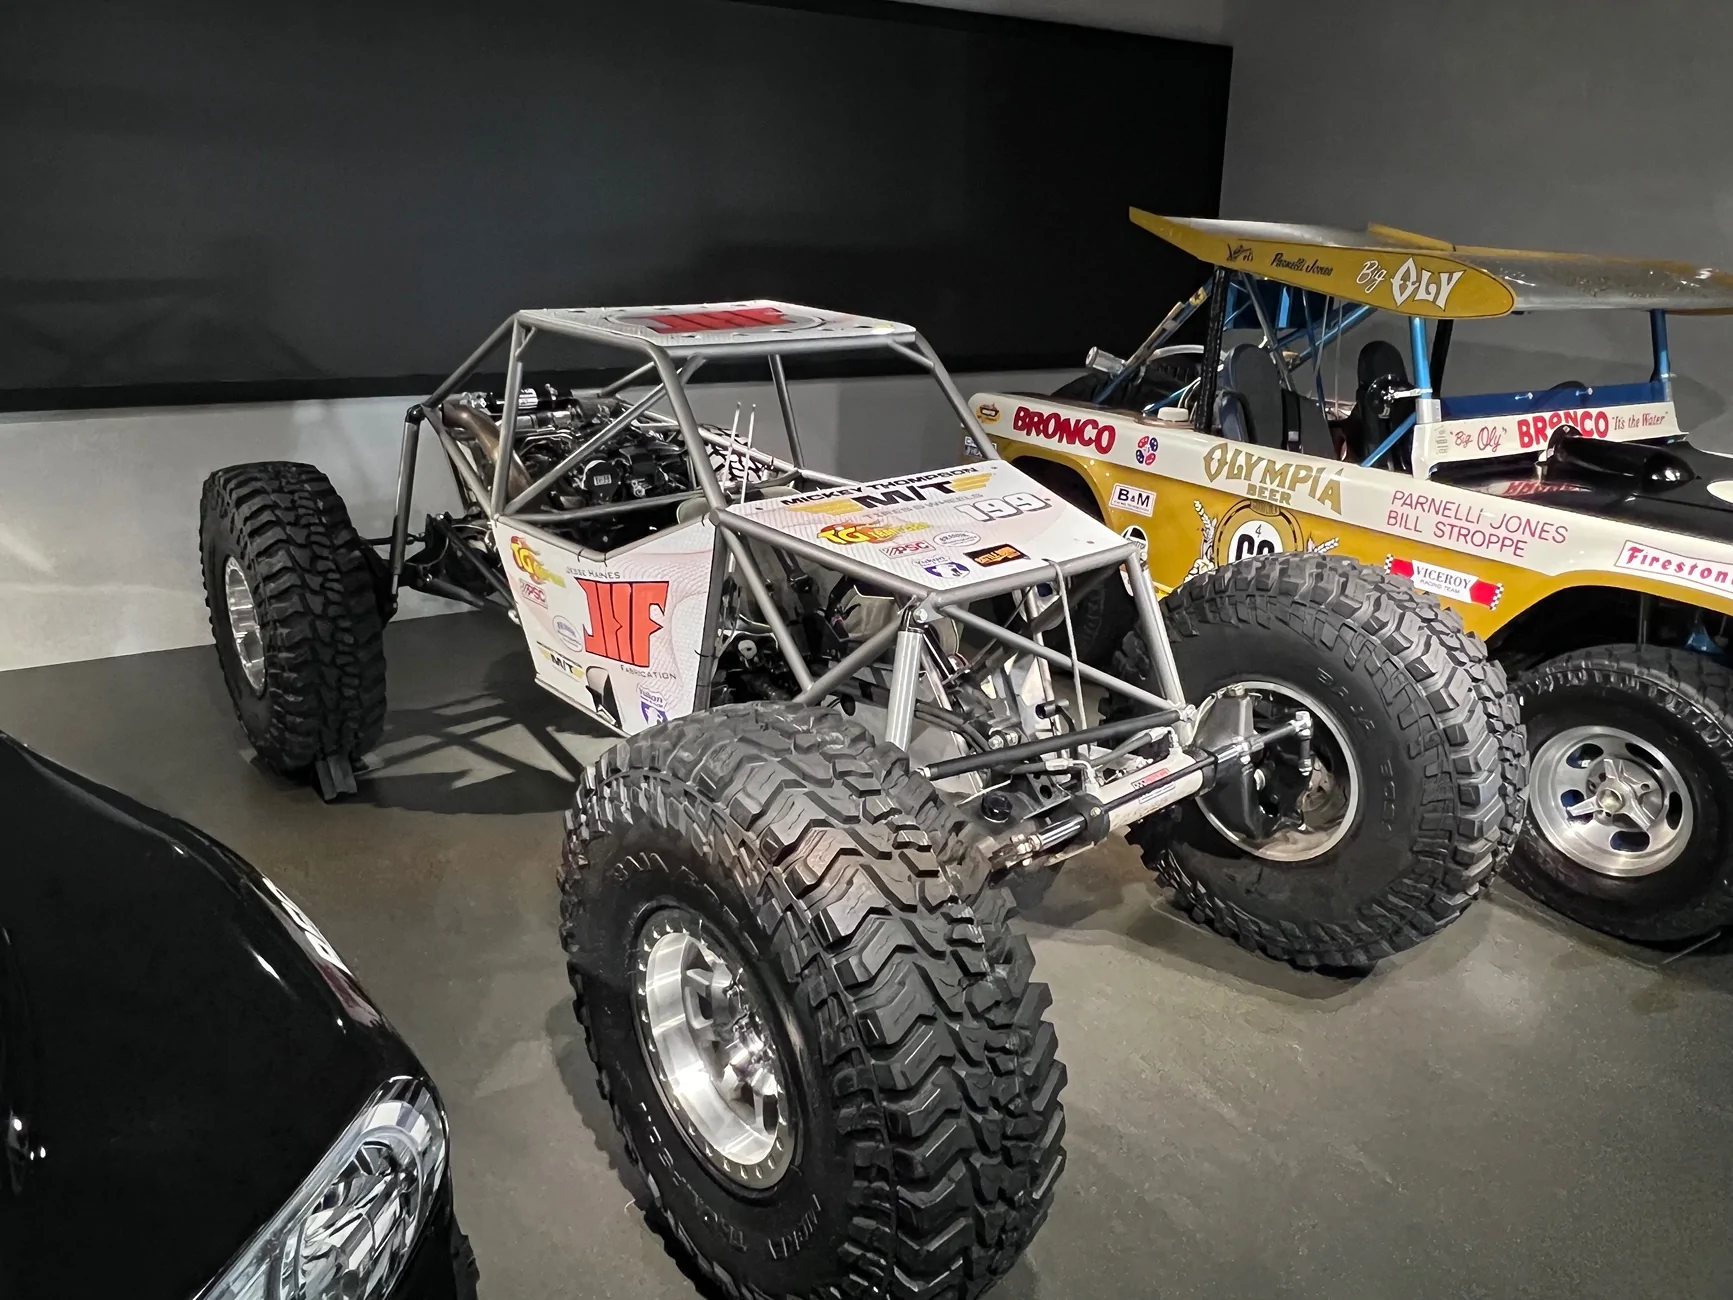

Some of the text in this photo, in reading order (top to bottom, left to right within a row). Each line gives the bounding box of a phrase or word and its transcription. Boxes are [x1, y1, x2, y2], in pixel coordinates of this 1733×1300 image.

[1356, 256, 1467, 312] Big OLY
[1013, 406, 1116, 455] BRONCO
[1517, 411, 1609, 448] BRONCO
[1628, 414, 1640, 428] the
[780, 467, 979, 506] MICKEY THOMPSON
[1203, 442, 1343, 515] OLYMPIA
[1246, 483, 1292, 505] BEER
[851, 480, 957, 509] M/T
[955, 491, 1052, 522] 199
[1386, 510, 1528, 558] BILL STROPPE
[1489, 513, 1568, 544] JONES
[895, 541, 930, 555] PSC
[1416, 565, 1471, 589] VICEROY
[1626, 546, 1733, 586] Fireston
[525, 584, 546, 603] PSC
[1444, 585, 1461, 594] TEAM
[621, 665, 676, 679] FABRICATION
